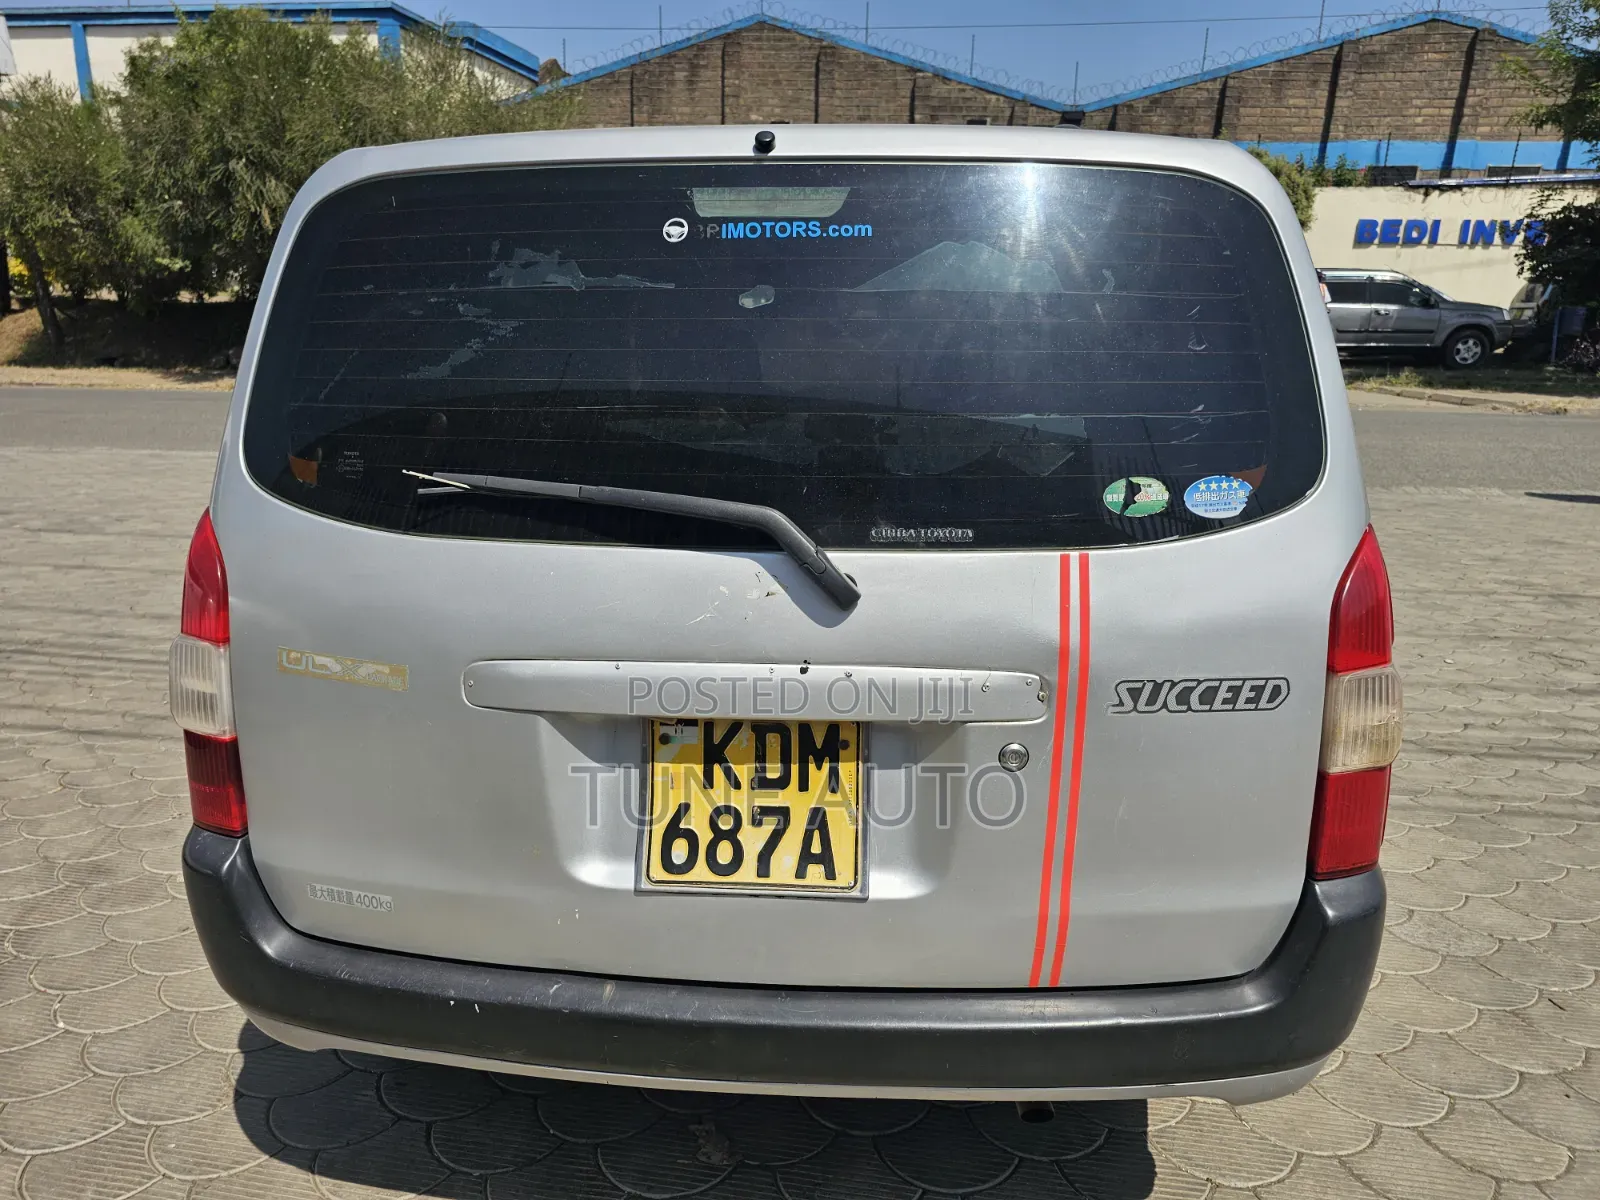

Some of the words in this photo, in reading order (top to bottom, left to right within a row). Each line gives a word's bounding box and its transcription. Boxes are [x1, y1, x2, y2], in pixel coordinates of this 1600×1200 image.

[1355, 219, 1441, 246] BEDI
[918, 527, 973, 541] TOYOTA
[1110, 678, 1290, 714] SUCCEED
[702, 721, 841, 793] KDM
[660, 802, 837, 881] 687A
